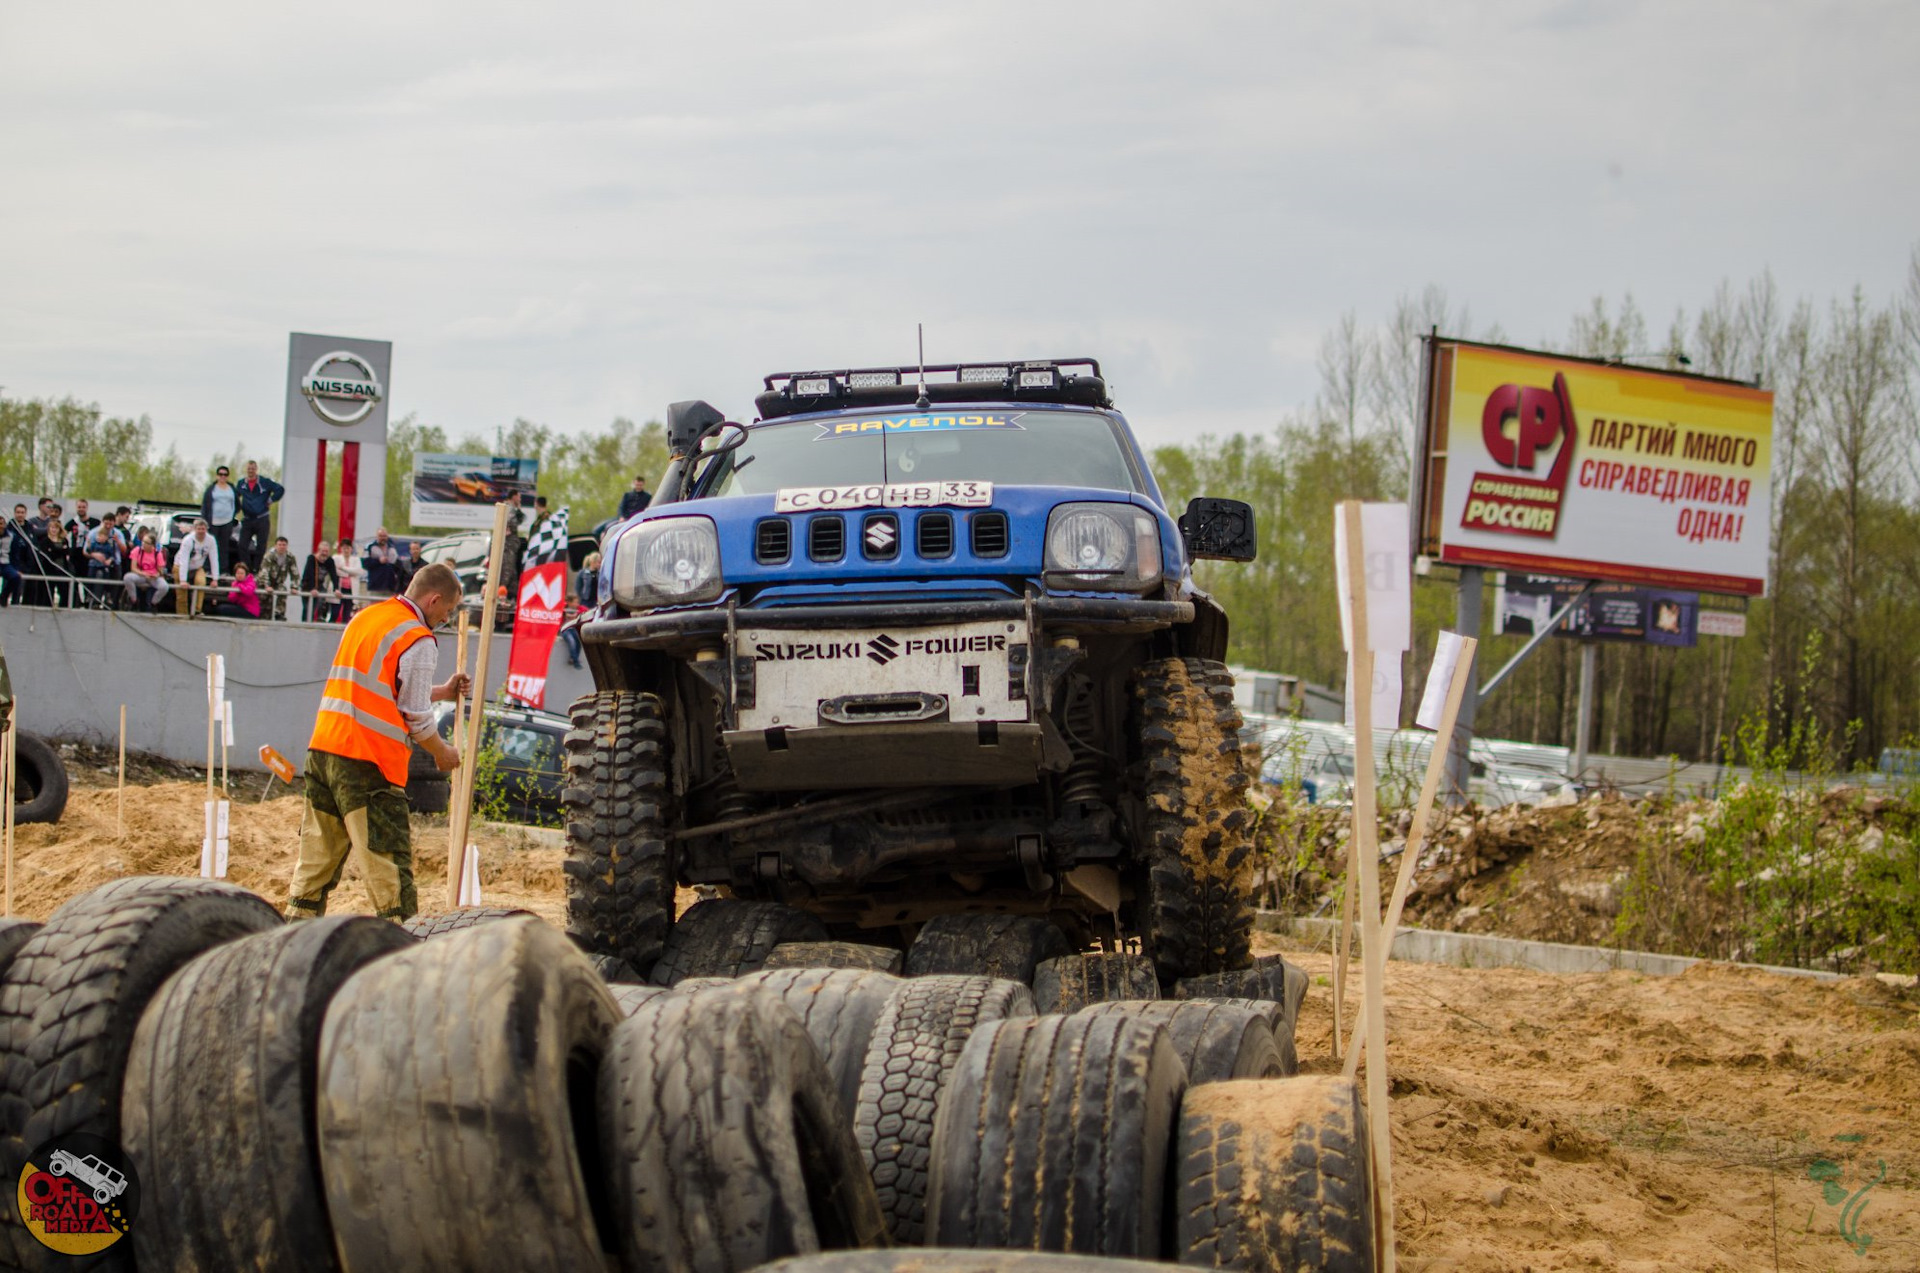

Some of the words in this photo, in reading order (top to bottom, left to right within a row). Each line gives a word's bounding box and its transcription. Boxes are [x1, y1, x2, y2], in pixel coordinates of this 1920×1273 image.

[312, 380, 376, 396] NISSAN
[835, 416, 1005, 434] RAVENOL
[1588, 418, 1678, 457] ПАРТИЙ
[1682, 430, 1758, 468] МНОГО
[945, 482, 977, 497] 33
[1473, 479, 1560, 503] СПРАВЕДЛИВАЯ
[1578, 458, 1751, 508] СПРАВЕДЛИВАЯ
[1465, 499, 1556, 532] РОССИЯ
[1676, 507, 1744, 543] ОДНА!
[531, 608, 562, 620] GROUP
[755, 642, 861, 661] SUZUKI
[906, 635, 1007, 656] POWER
